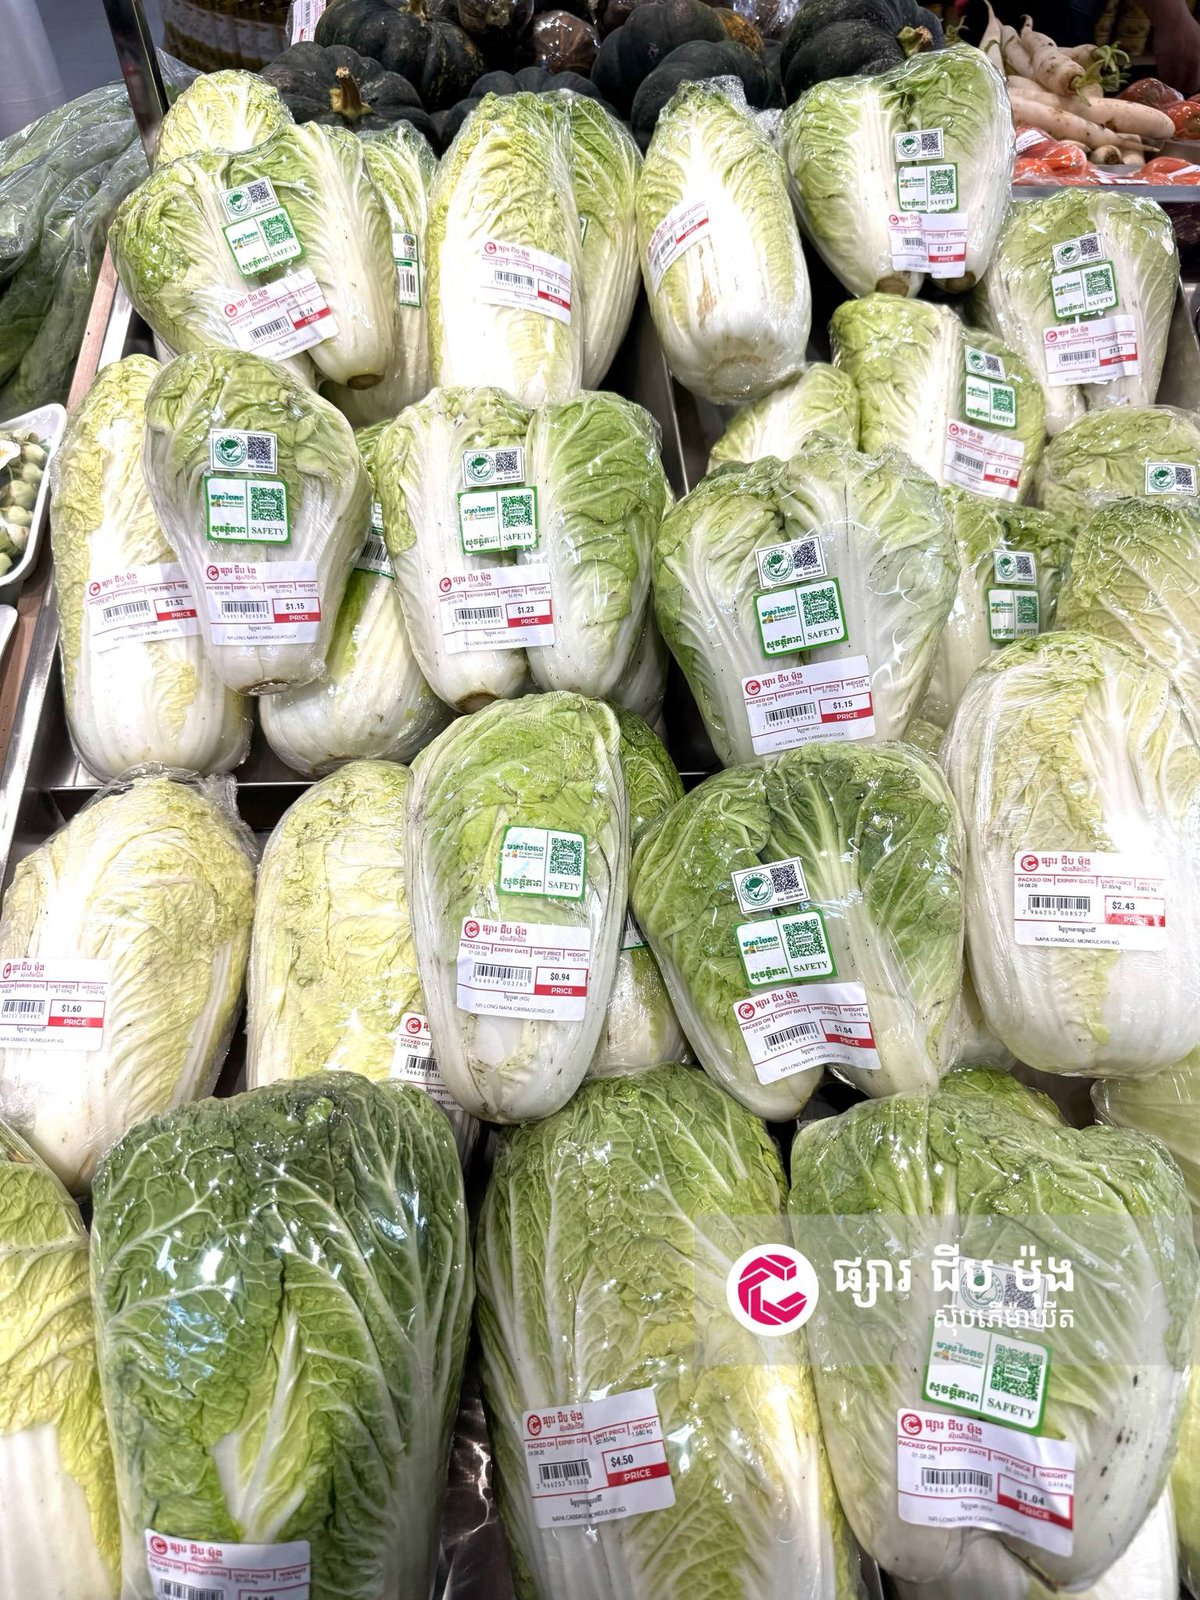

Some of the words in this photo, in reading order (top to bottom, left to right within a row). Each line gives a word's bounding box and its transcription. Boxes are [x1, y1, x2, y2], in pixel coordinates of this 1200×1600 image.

[930, 198, 953, 206] SAFETY
[1088, 296, 1114, 307] SAFETY
[992, 414, 1014, 423] SAFETY
[251, 526, 285, 536] SAFETY
[504, 532, 533, 541] SAFETY
[285, 603, 305, 611] $1.15
[518, 606, 535, 614] $1.23
[807, 627, 840, 640] SAFETY
[846, 679, 866, 687] WEIGHT
[746, 698, 765, 706] PACKED
[833, 700, 853, 710] $1.15
[836, 712, 858, 720] PRICE
[548, 880, 580, 891] SAFETY
[1111, 901, 1135, 911] $2.43
[793, 961, 828, 972] SAFETY
[550, 972, 570, 981] $0.94
[61, 1003, 82, 1013] $1.60
[775, 1011, 793, 1019] EXPIRY
[63, 1018, 88, 1026] PRICE
[742, 1021, 763, 1031] PACKED
[834, 1024, 853, 1034] $1.04
[400, 1037, 421, 1045] PACKED
[840, 1036, 860, 1046] PRICE
[987, 1397, 1036, 1419] SAFETY
[632, 1421, 657, 1431] WEIGHT
[593, 1432, 608, 1440] UNIT
[609, 1427, 626, 1436] PRICE
[899, 1440, 926, 1450] PACKED
[968, 1449, 987, 1457] DATE
[610, 1455, 634, 1468] $4.50
[993, 1454, 1009, 1464] UNIT
[1010, 1461, 1031, 1472] PRICE
[624, 1468, 652, 1481] PRICE
[1039, 1471, 1068, 1480] WEIGHT
[1016, 1489, 1045, 1506] $1.04
[1018, 1503, 1050, 1519] PRICE
